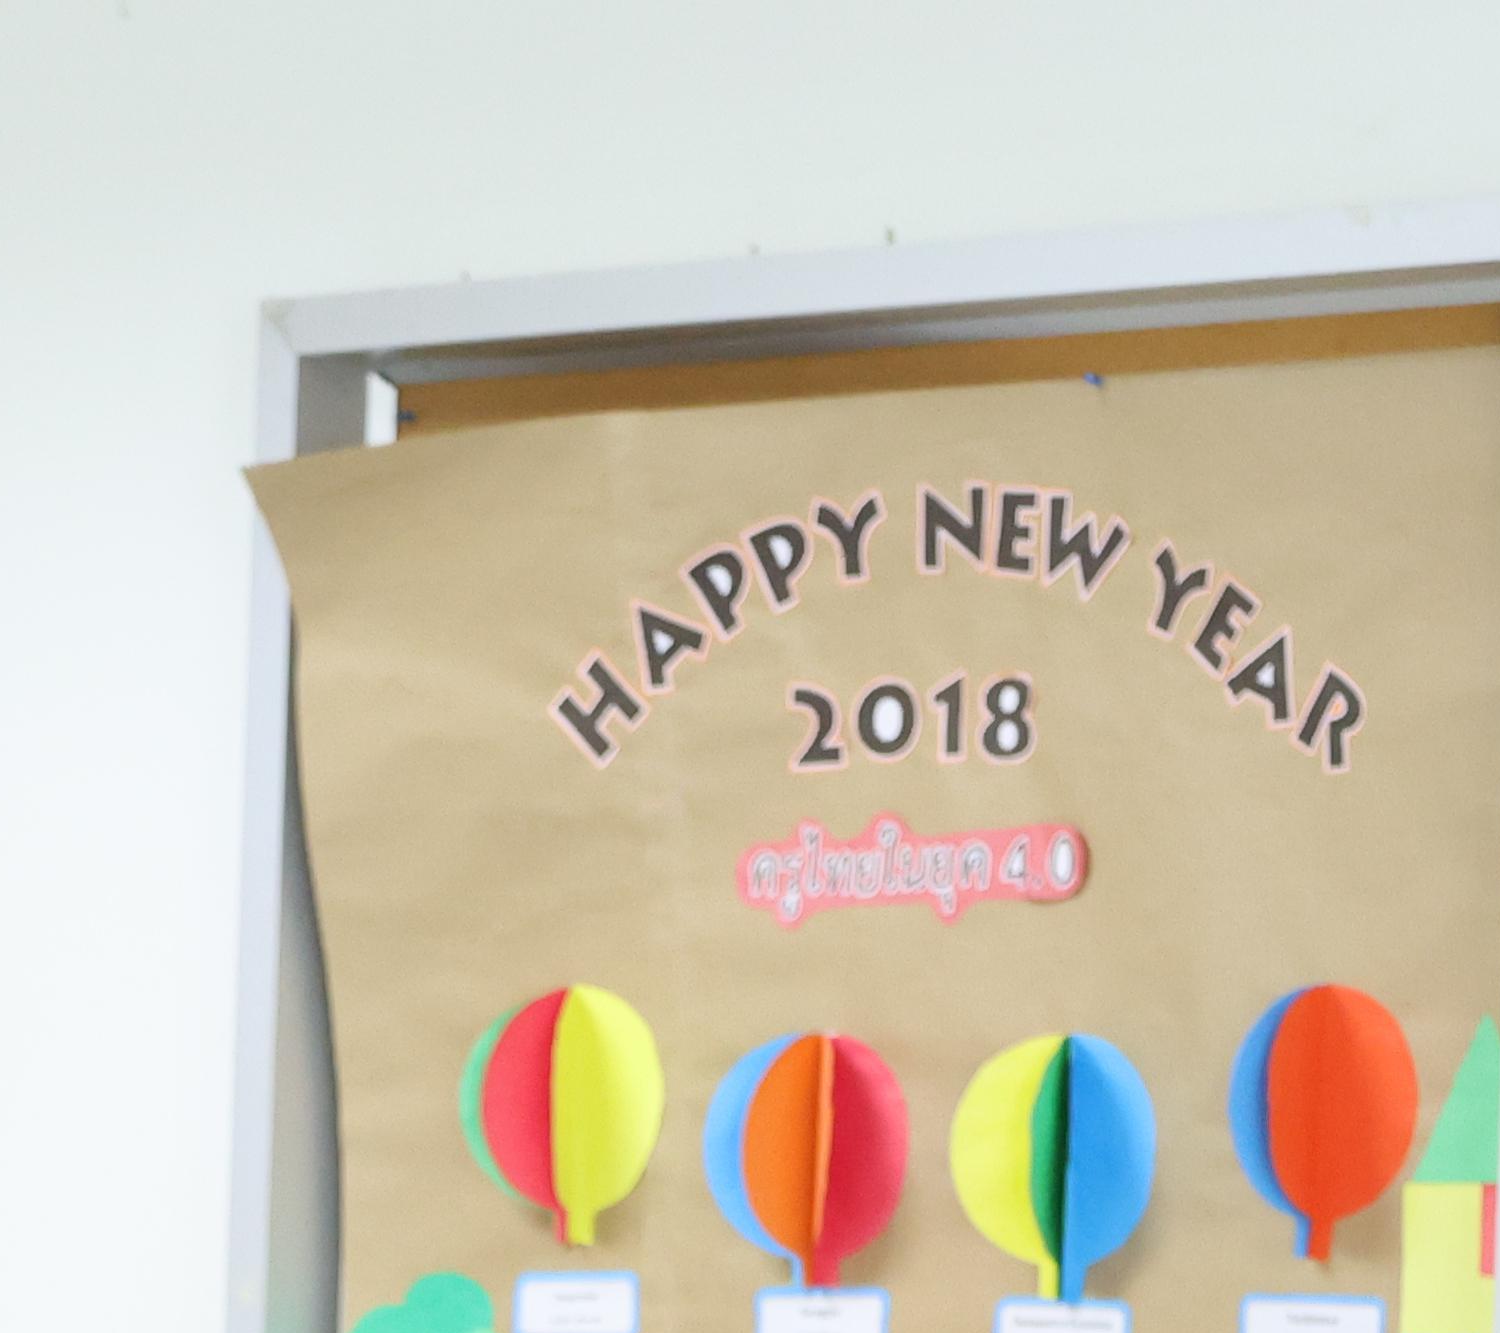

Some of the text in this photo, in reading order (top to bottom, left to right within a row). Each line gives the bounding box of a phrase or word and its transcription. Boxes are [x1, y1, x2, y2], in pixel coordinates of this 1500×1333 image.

[555, 484, 1366, 771] HAPPY NEW YEAR
[792, 674, 1033, 768] 2018
[1001, 833, 1079, 890] 4.0
